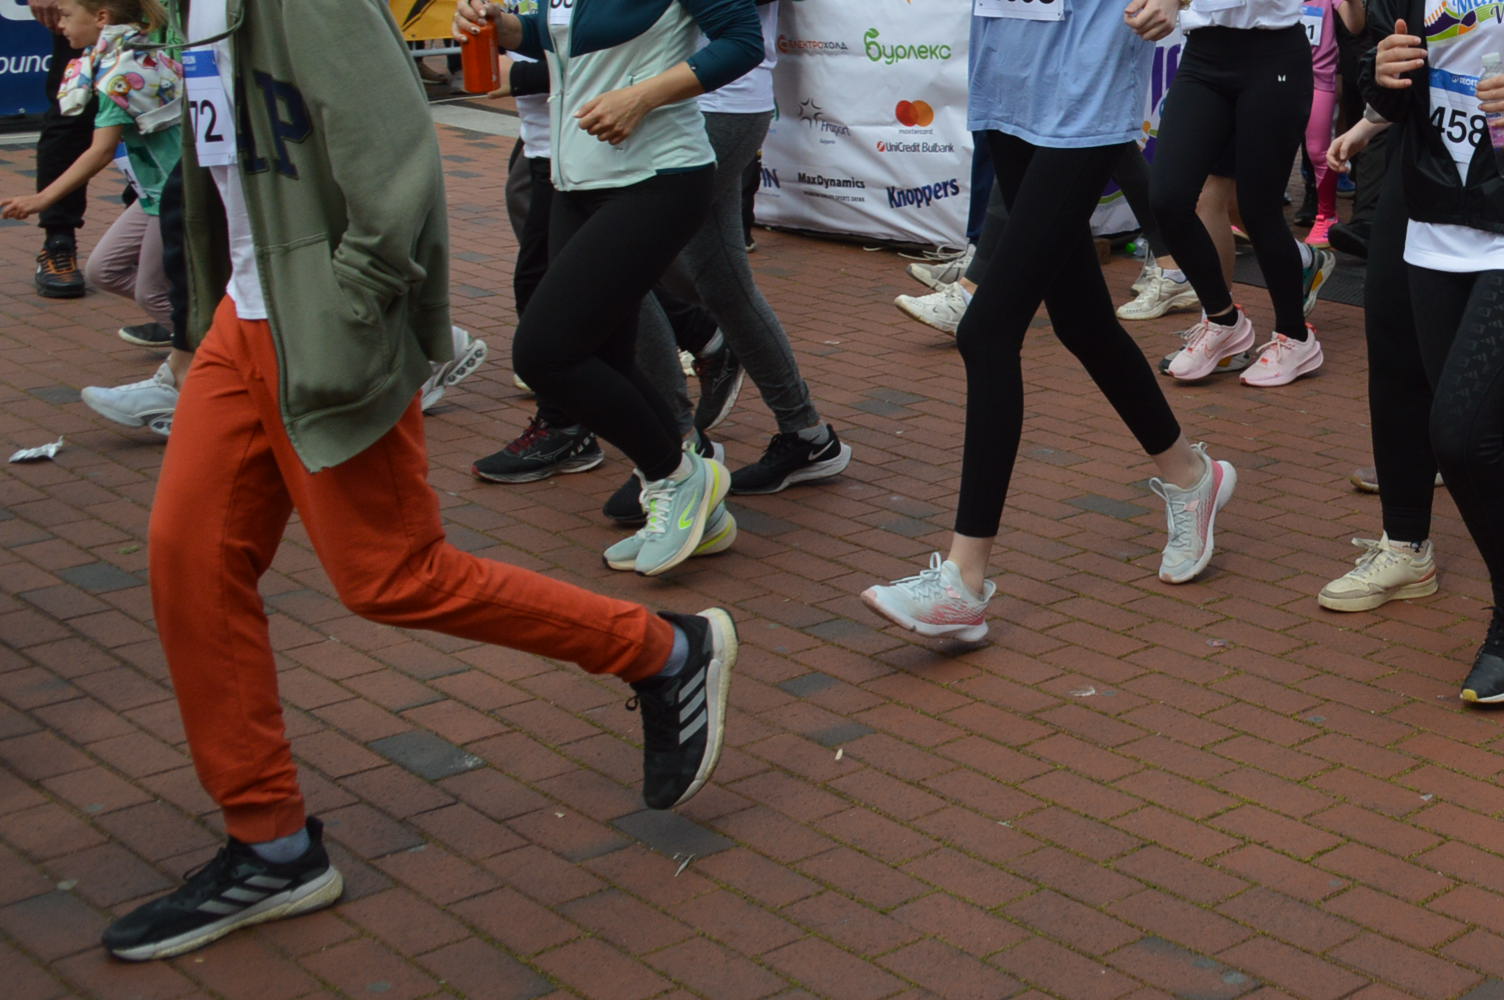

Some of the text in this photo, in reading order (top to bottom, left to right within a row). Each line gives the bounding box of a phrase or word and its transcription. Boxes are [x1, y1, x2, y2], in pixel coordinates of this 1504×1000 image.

[886, 142, 955, 154] UniCredit Bulbank
[798, 172, 866, 190] MaxDynamics
[886, 178, 961, 209] Knoppers
